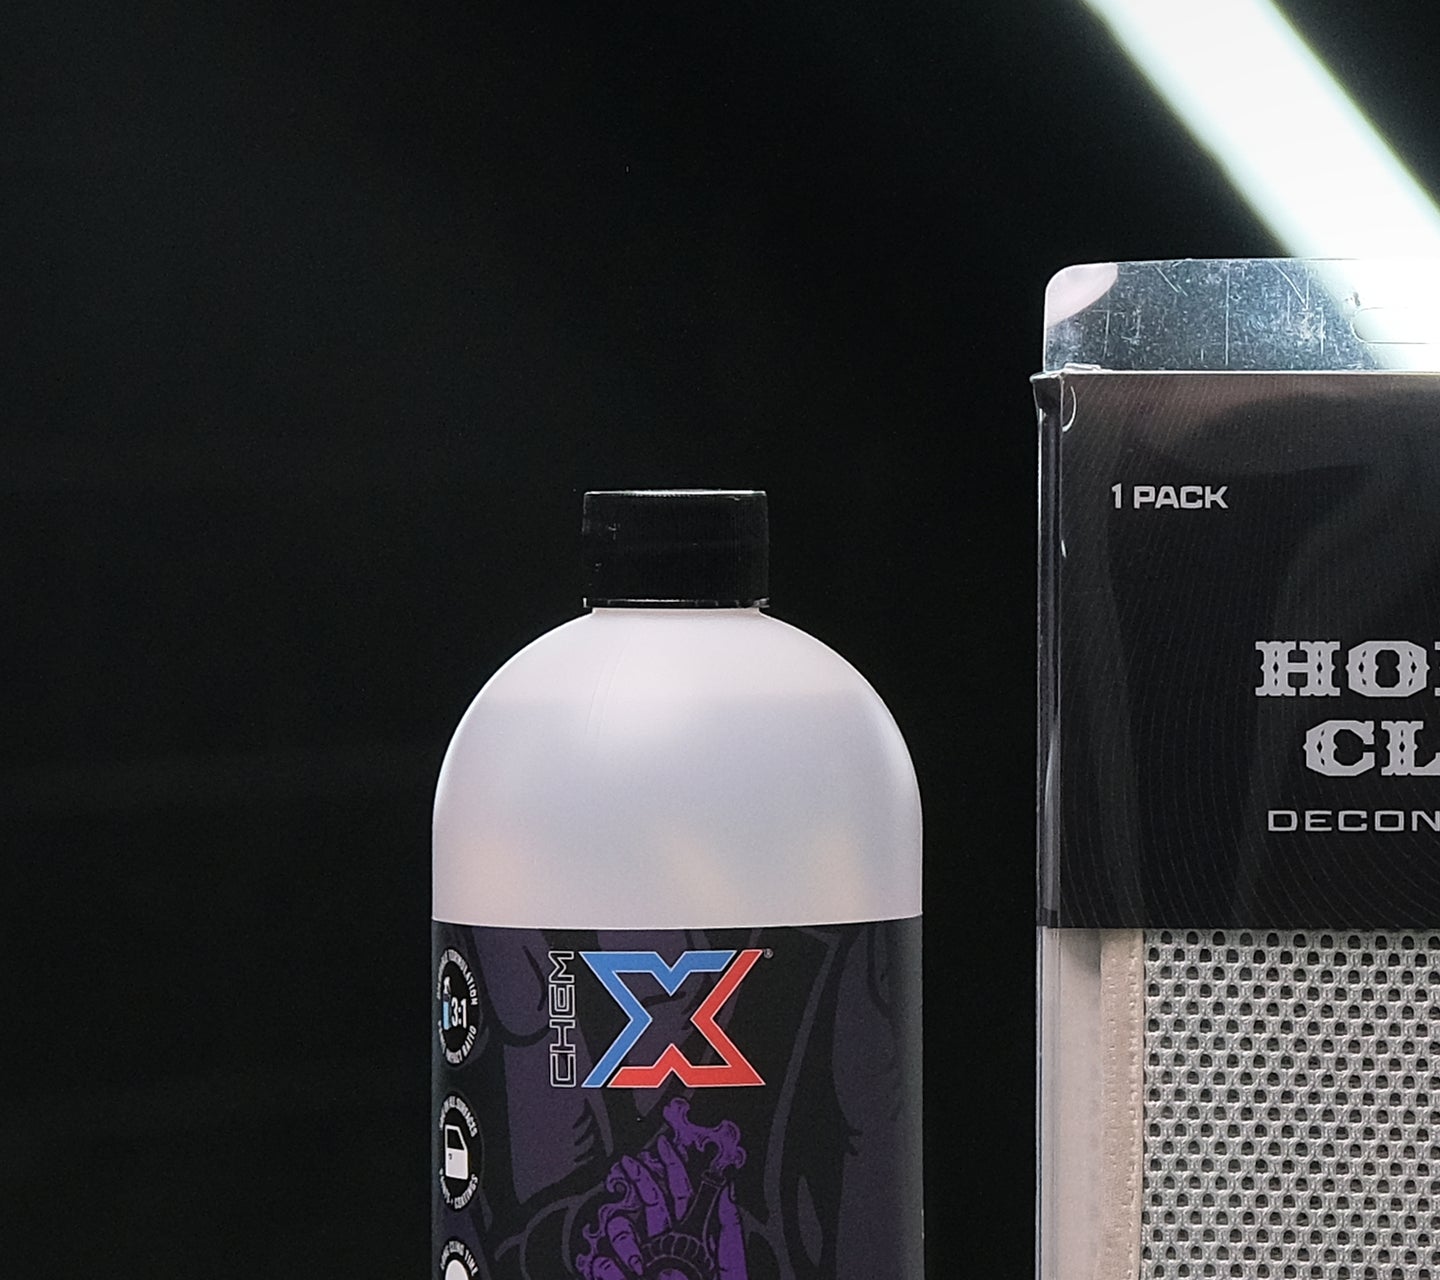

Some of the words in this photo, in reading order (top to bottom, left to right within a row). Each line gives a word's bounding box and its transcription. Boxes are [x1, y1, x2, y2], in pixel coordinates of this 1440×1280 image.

[1111, 483, 1122, 509] 1
[1133, 485, 1229, 509] PACK
[1267, 810, 1440, 832] DECON
[450, 996, 468, 1029] 3:1
[547, 950, 577, 1088] CHEM
